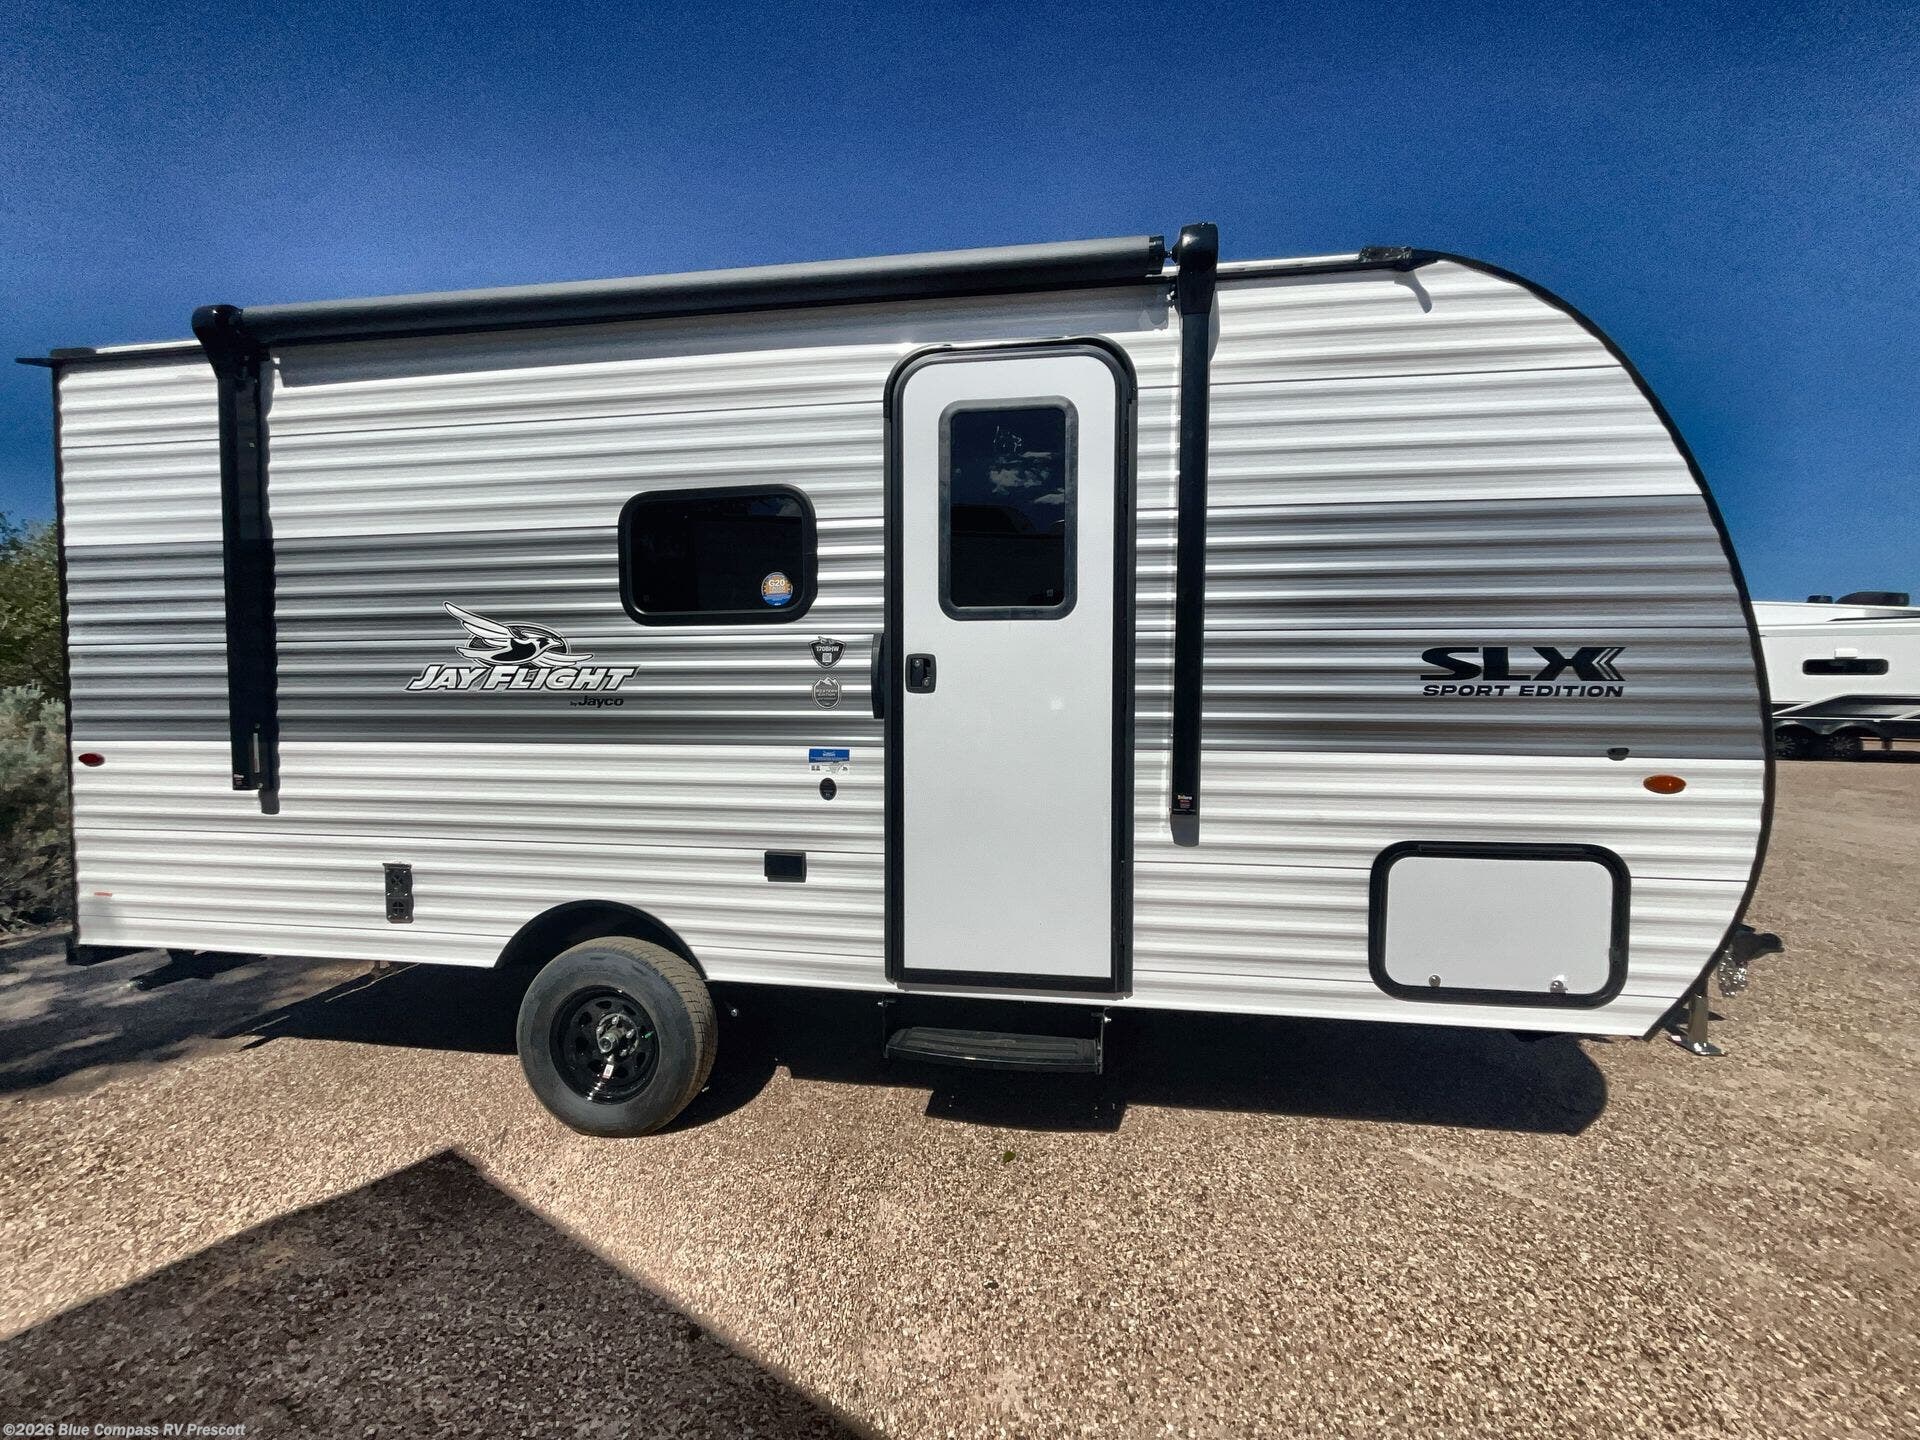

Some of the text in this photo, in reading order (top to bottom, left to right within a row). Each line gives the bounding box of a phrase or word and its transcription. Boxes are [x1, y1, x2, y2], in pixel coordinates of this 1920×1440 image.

[1420, 646, 1626, 681] SLX
[405, 663, 639, 692] JAY FLIGHT
[578, 695, 624, 708] Jayco
[1423, 684, 1624, 698] SPORT EDITION
